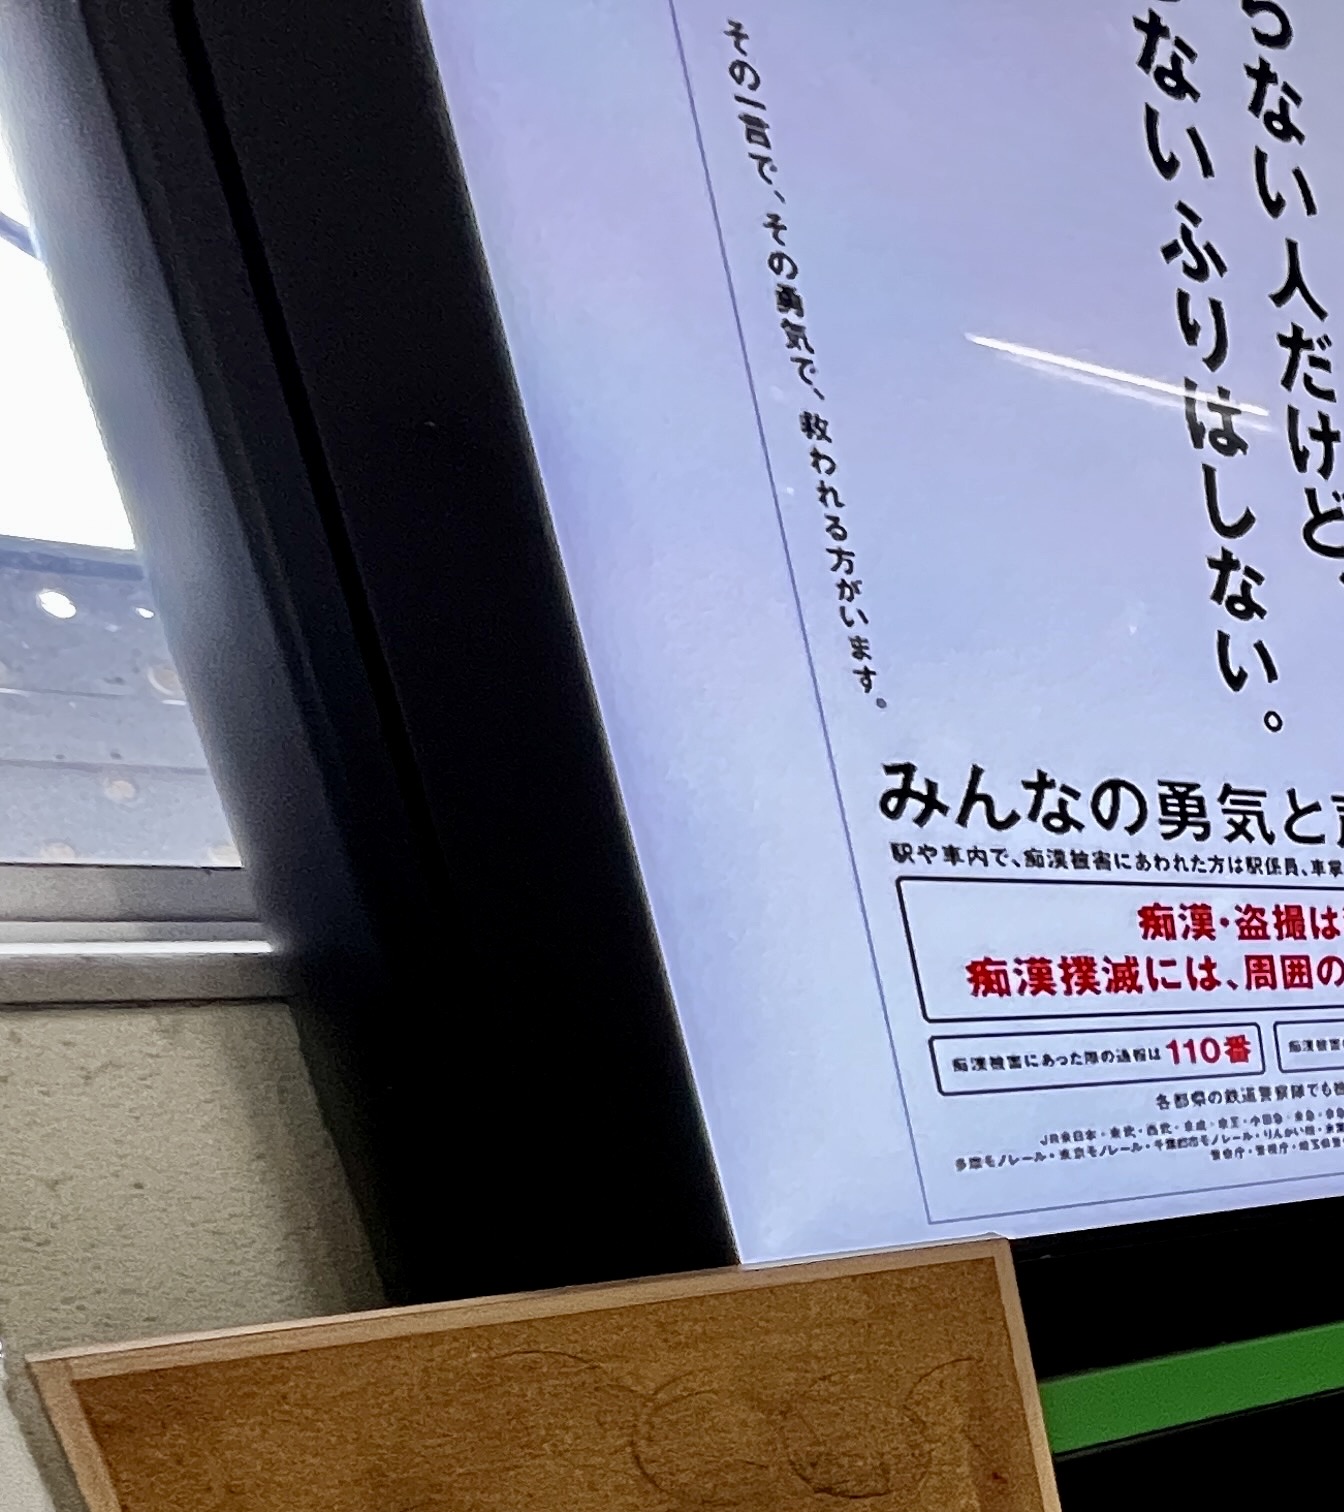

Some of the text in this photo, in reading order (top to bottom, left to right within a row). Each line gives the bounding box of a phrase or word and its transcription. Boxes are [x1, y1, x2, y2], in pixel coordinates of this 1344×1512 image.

[724, 17, 889, 710] その一言で、その勇気で、救われる方がいます。
[1166, 1035, 1251, 1065] 110番
